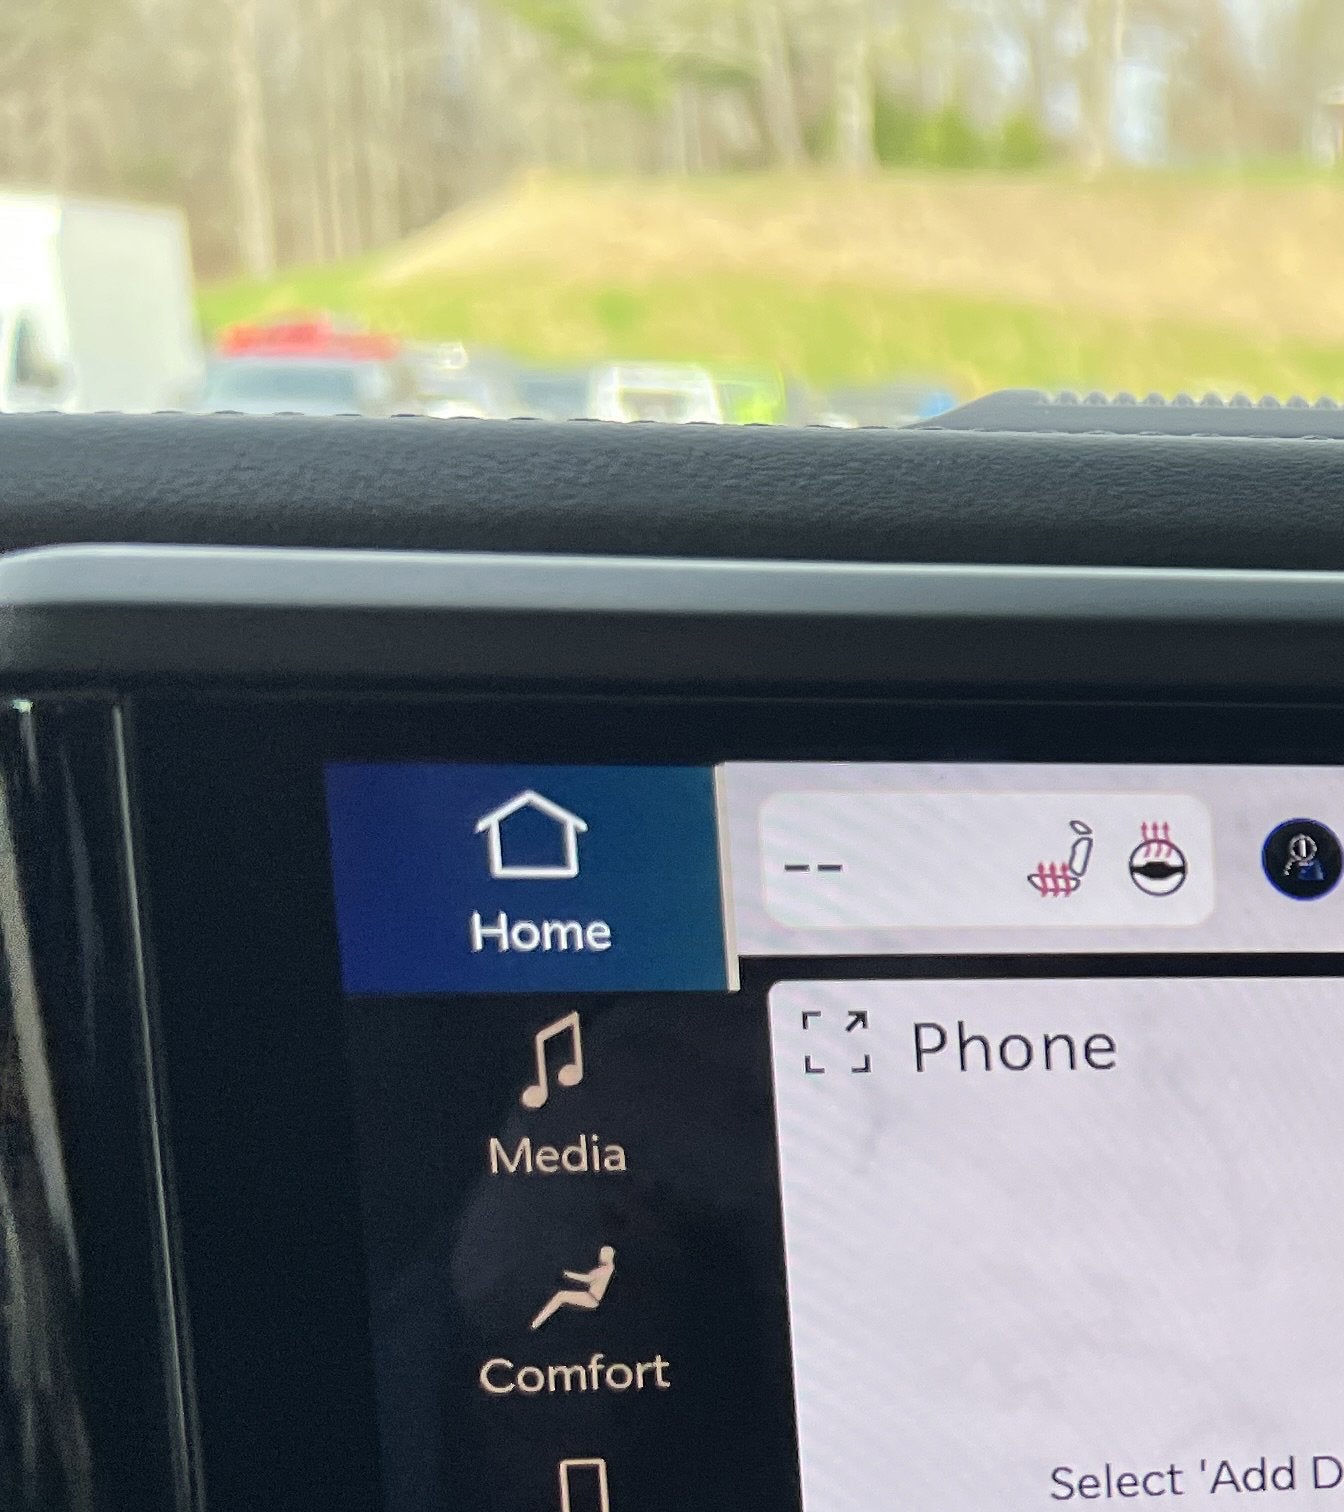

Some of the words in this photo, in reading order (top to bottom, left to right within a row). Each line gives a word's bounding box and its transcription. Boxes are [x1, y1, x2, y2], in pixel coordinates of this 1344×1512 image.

[471, 911, 612, 952] Home
[914, 1020, 1116, 1073] Phone
[489, 1133, 627, 1174] Media
[479, 1353, 671, 1394] Comfort
[1051, 1463, 1184, 1501] Select
[1200, 1455, 1296, 1494] 'Add
